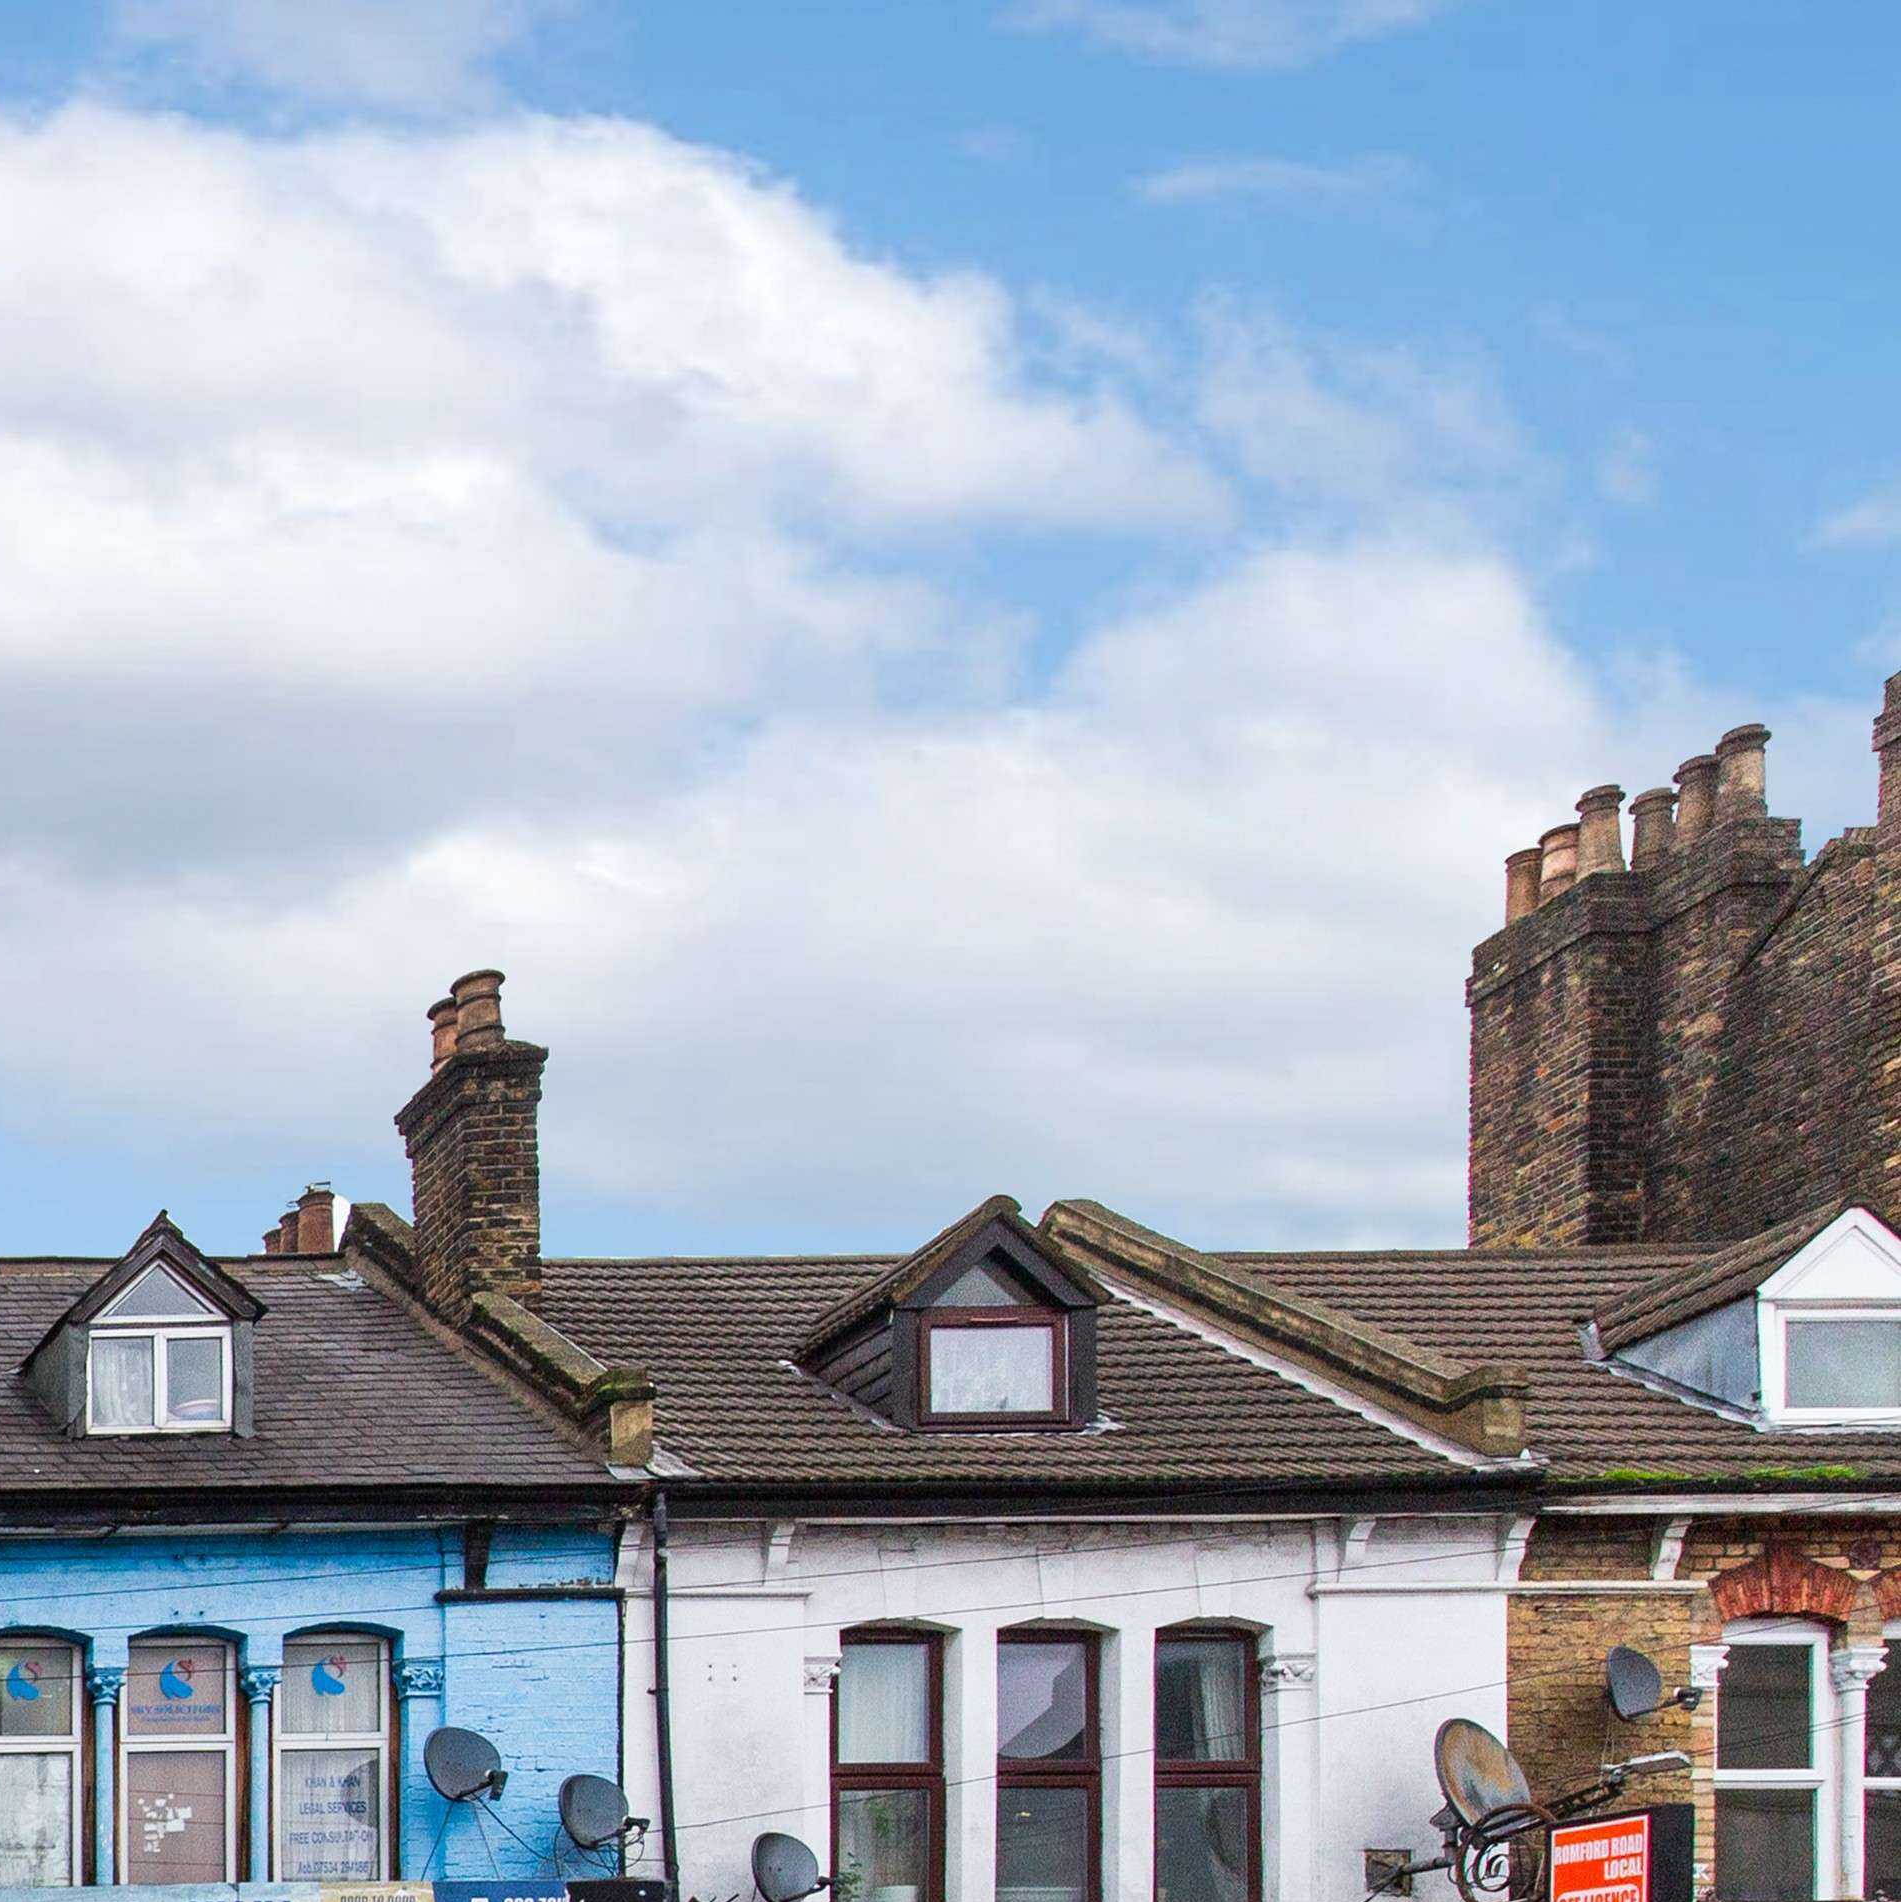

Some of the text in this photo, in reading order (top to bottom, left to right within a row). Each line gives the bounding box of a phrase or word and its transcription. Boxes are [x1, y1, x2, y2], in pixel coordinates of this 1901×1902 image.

[1555, 1834, 1643, 1864] ROMFORD ROAD
[1604, 1856, 1643, 1880] LOCAL
